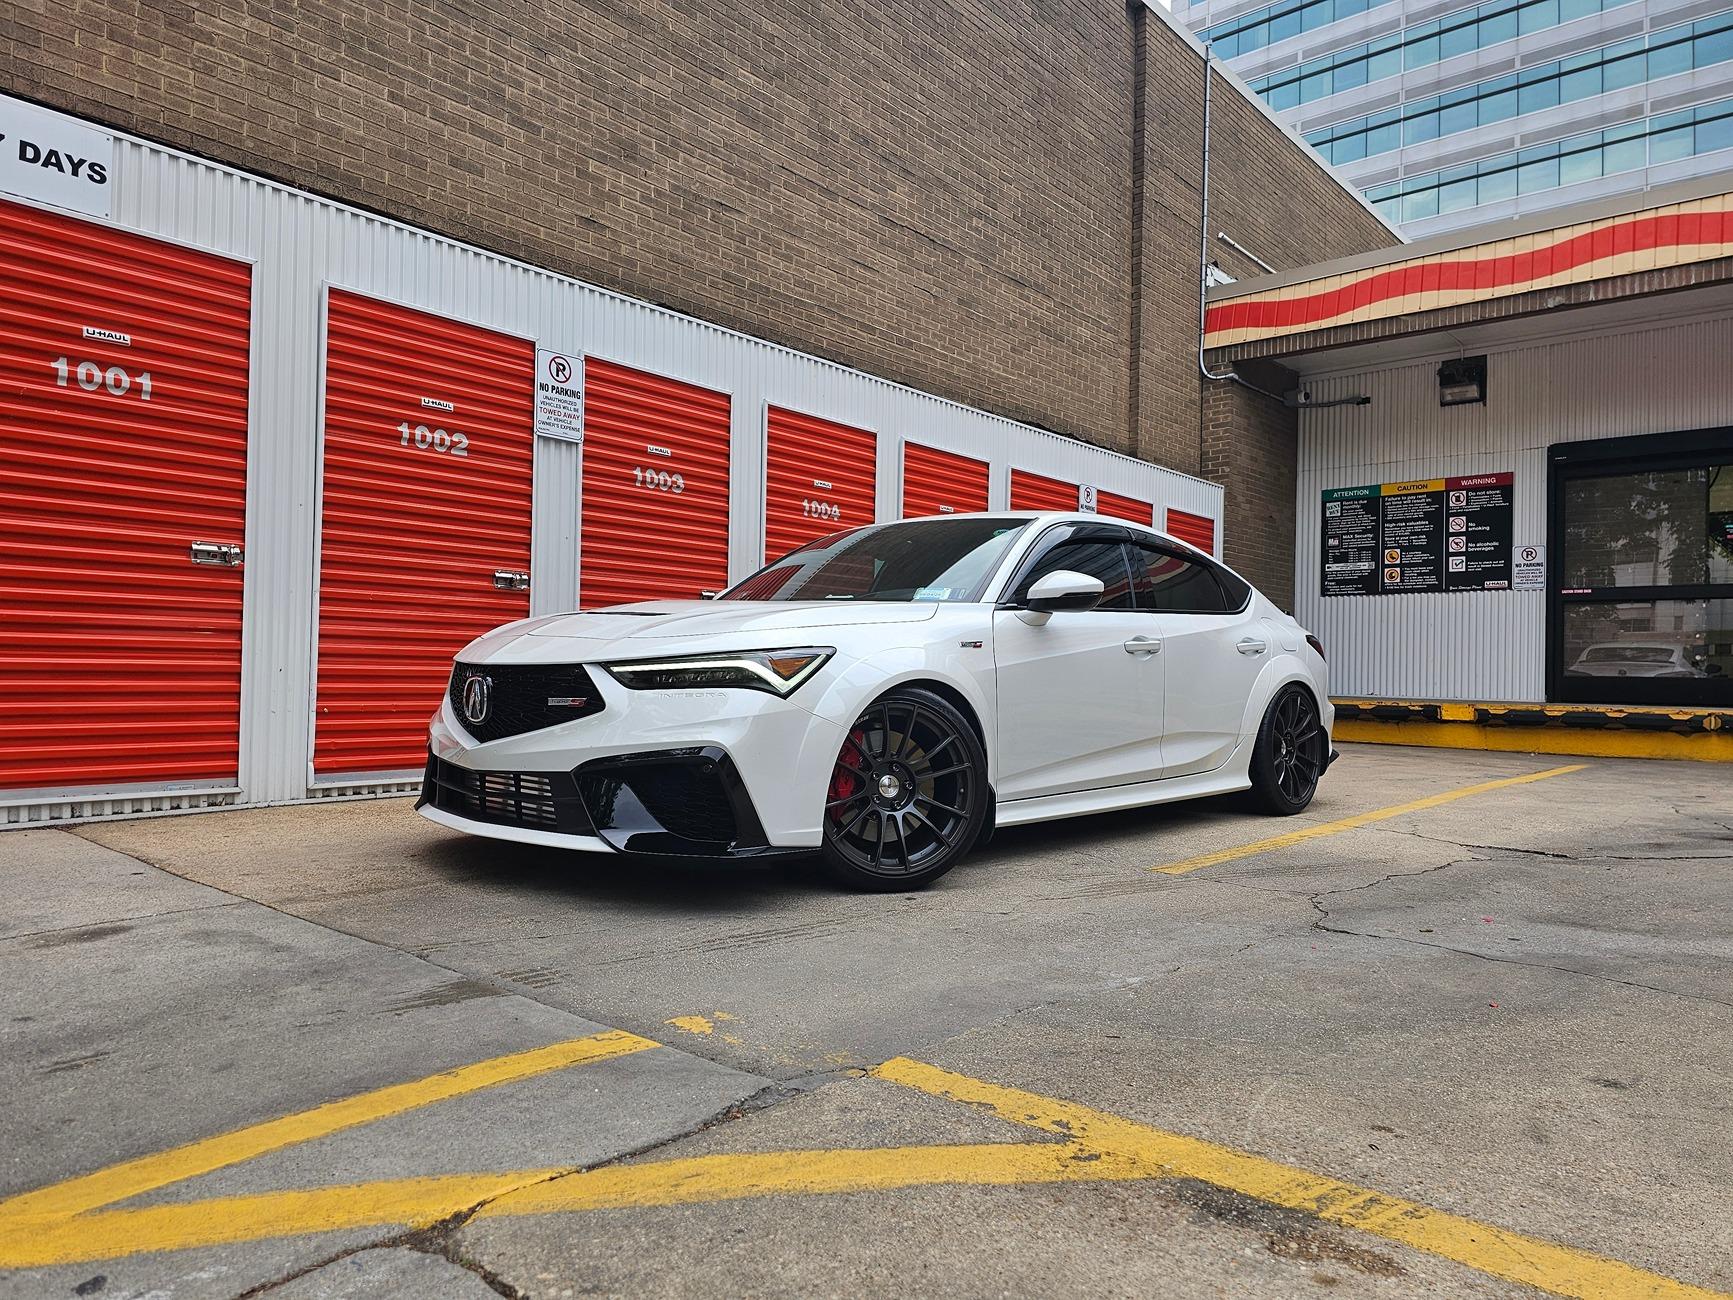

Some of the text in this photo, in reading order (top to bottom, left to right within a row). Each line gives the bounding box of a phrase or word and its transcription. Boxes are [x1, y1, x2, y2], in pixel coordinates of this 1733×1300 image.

[19, 140, 107, 184] DAYS
[86, 328, 128, 342] U-HAUL
[50, 357, 152, 400] 1001
[540, 382, 580, 399] NO PARKING
[423, 398, 452, 409] U-HAUL
[540, 401, 561, 409] VEHICLES
[543, 395, 577, 406] UNAUTHORIZED
[540, 407, 580, 420] TOWED AWAY
[554, 417, 572, 425] VEHICLE
[397, 422, 469, 456] 1002
[633, 467, 684, 493] 1003
[1461, 477, 1496, 486] WARNING
[1333, 489, 1369, 498] ATTENTION
[803, 499, 840, 521] 1004
